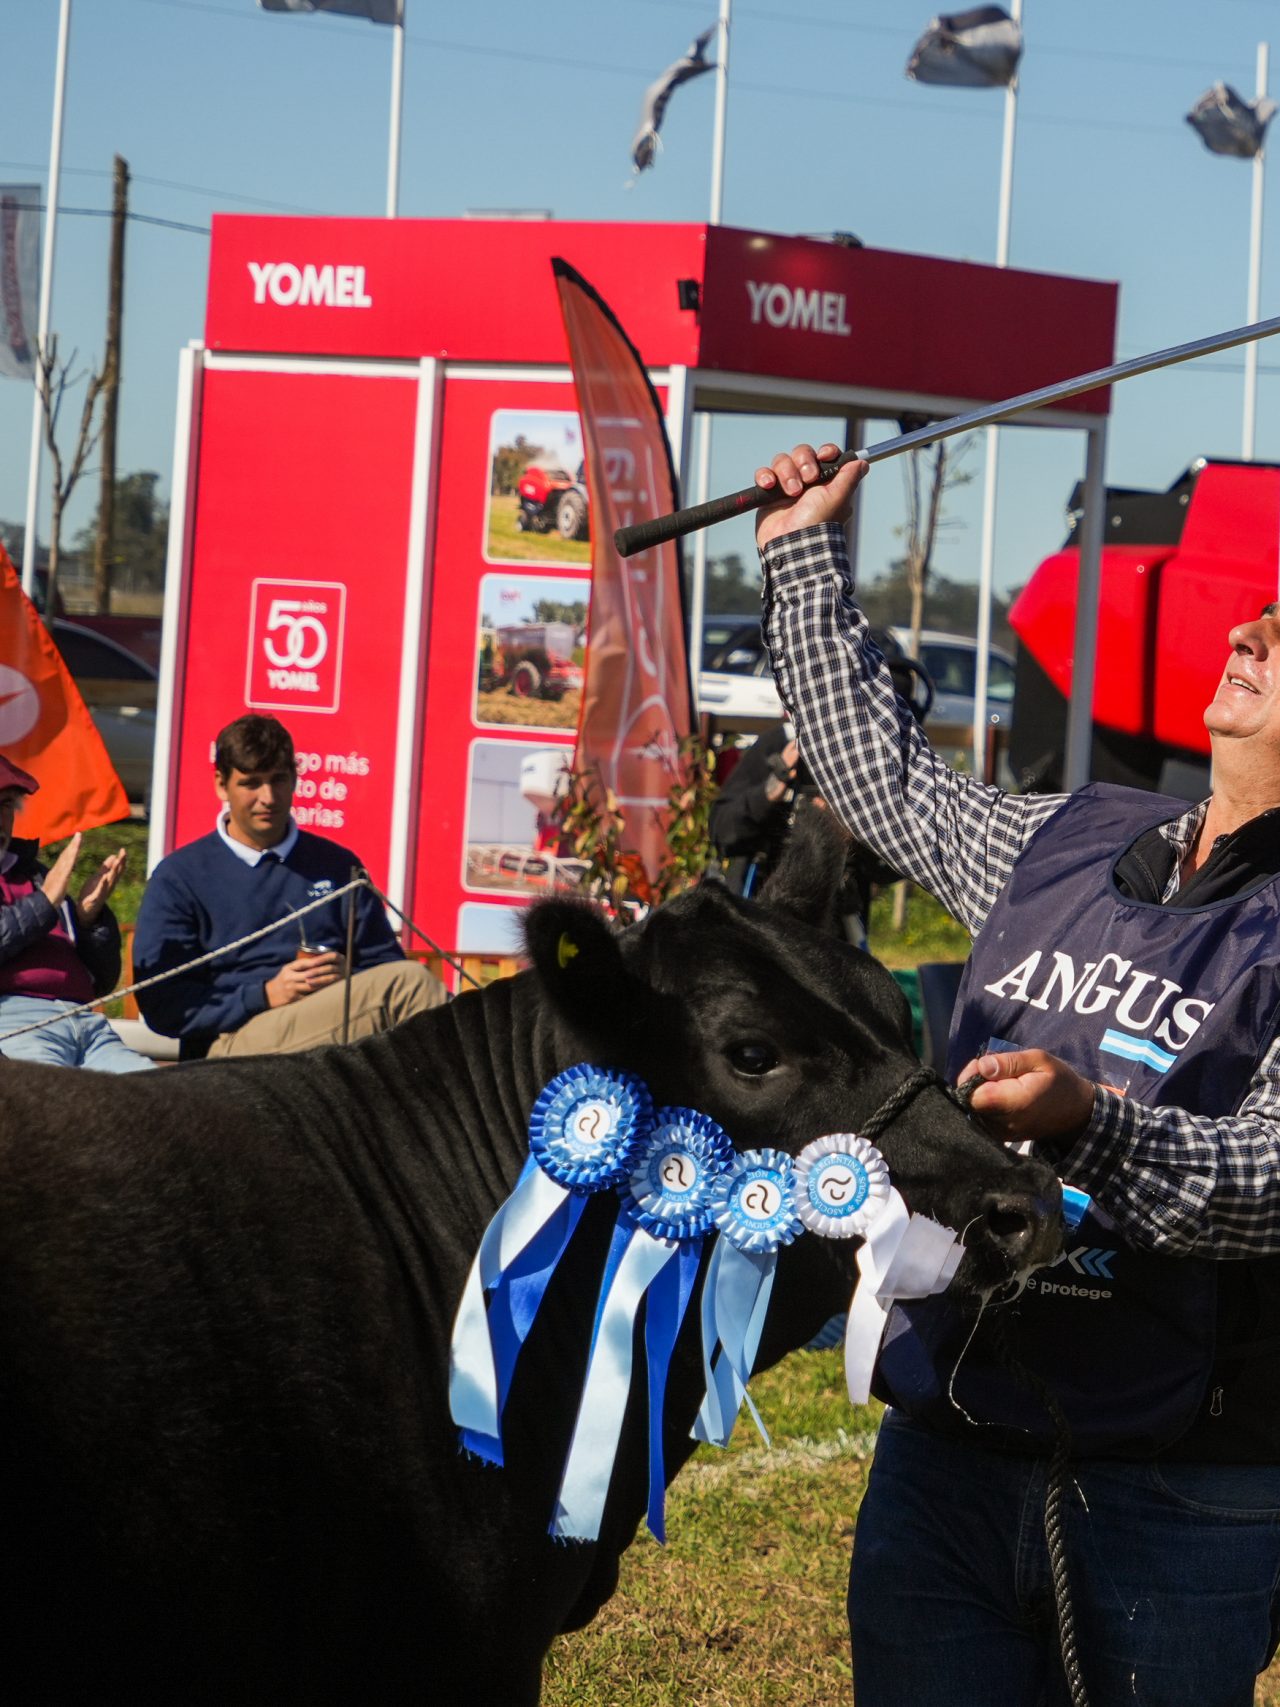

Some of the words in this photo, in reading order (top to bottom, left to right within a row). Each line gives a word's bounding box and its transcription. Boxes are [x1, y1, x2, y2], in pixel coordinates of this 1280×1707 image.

[247, 261, 373, 308] YOMEL
[745, 280, 852, 336] YOMEL
[263, 600, 329, 669] 50
[266, 669, 321, 693] YOMEL
[294, 752, 322, 776] go
[325, 751, 370, 776] más
[295, 776, 317, 798] to
[320, 776, 348, 802] de
[984, 950, 1216, 1051] ANGUS
[855, 1176, 868, 1206] ANGUS
[744, 1219, 772, 1229] ANGUS
[1040, 1281, 1113, 1300] protege
